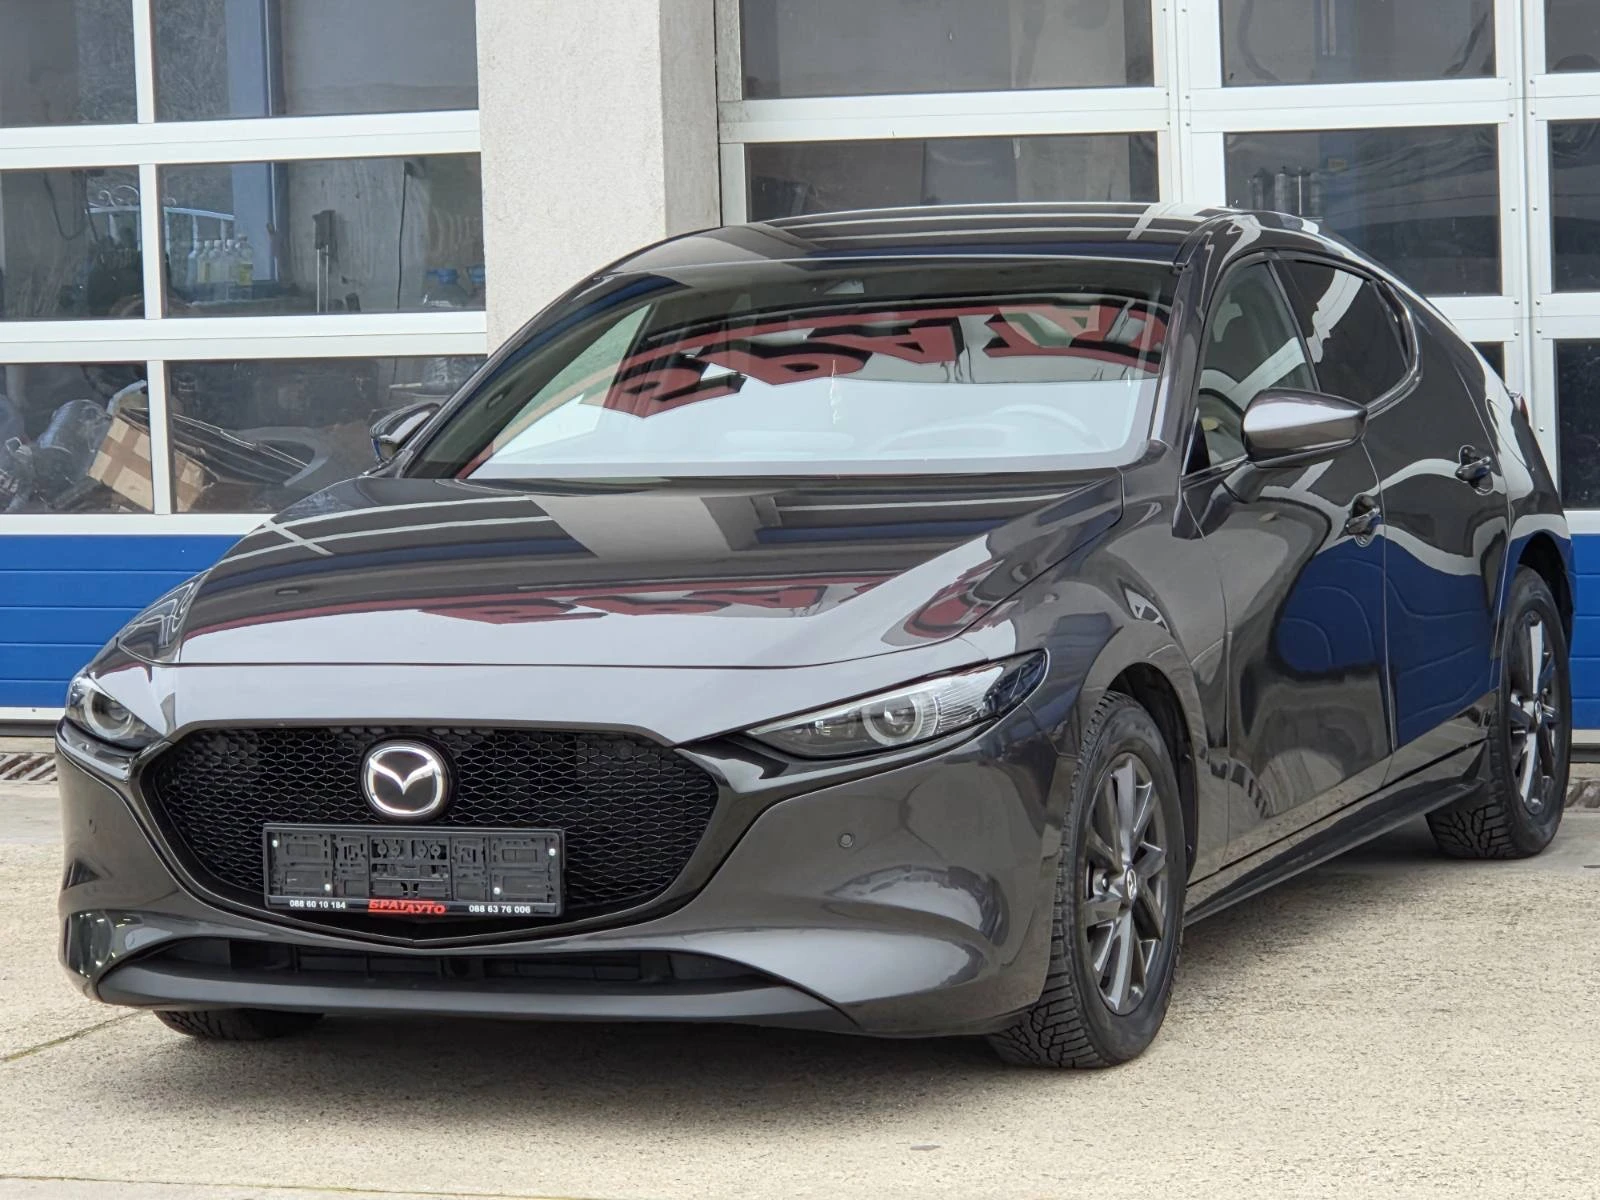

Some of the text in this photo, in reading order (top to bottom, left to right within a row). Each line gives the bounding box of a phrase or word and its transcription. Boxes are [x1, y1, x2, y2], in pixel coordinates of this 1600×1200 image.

[289, 899, 304, 907] 088
[331, 901, 346, 909] 184
[468, 905, 531, 914] 088 63 76 006
